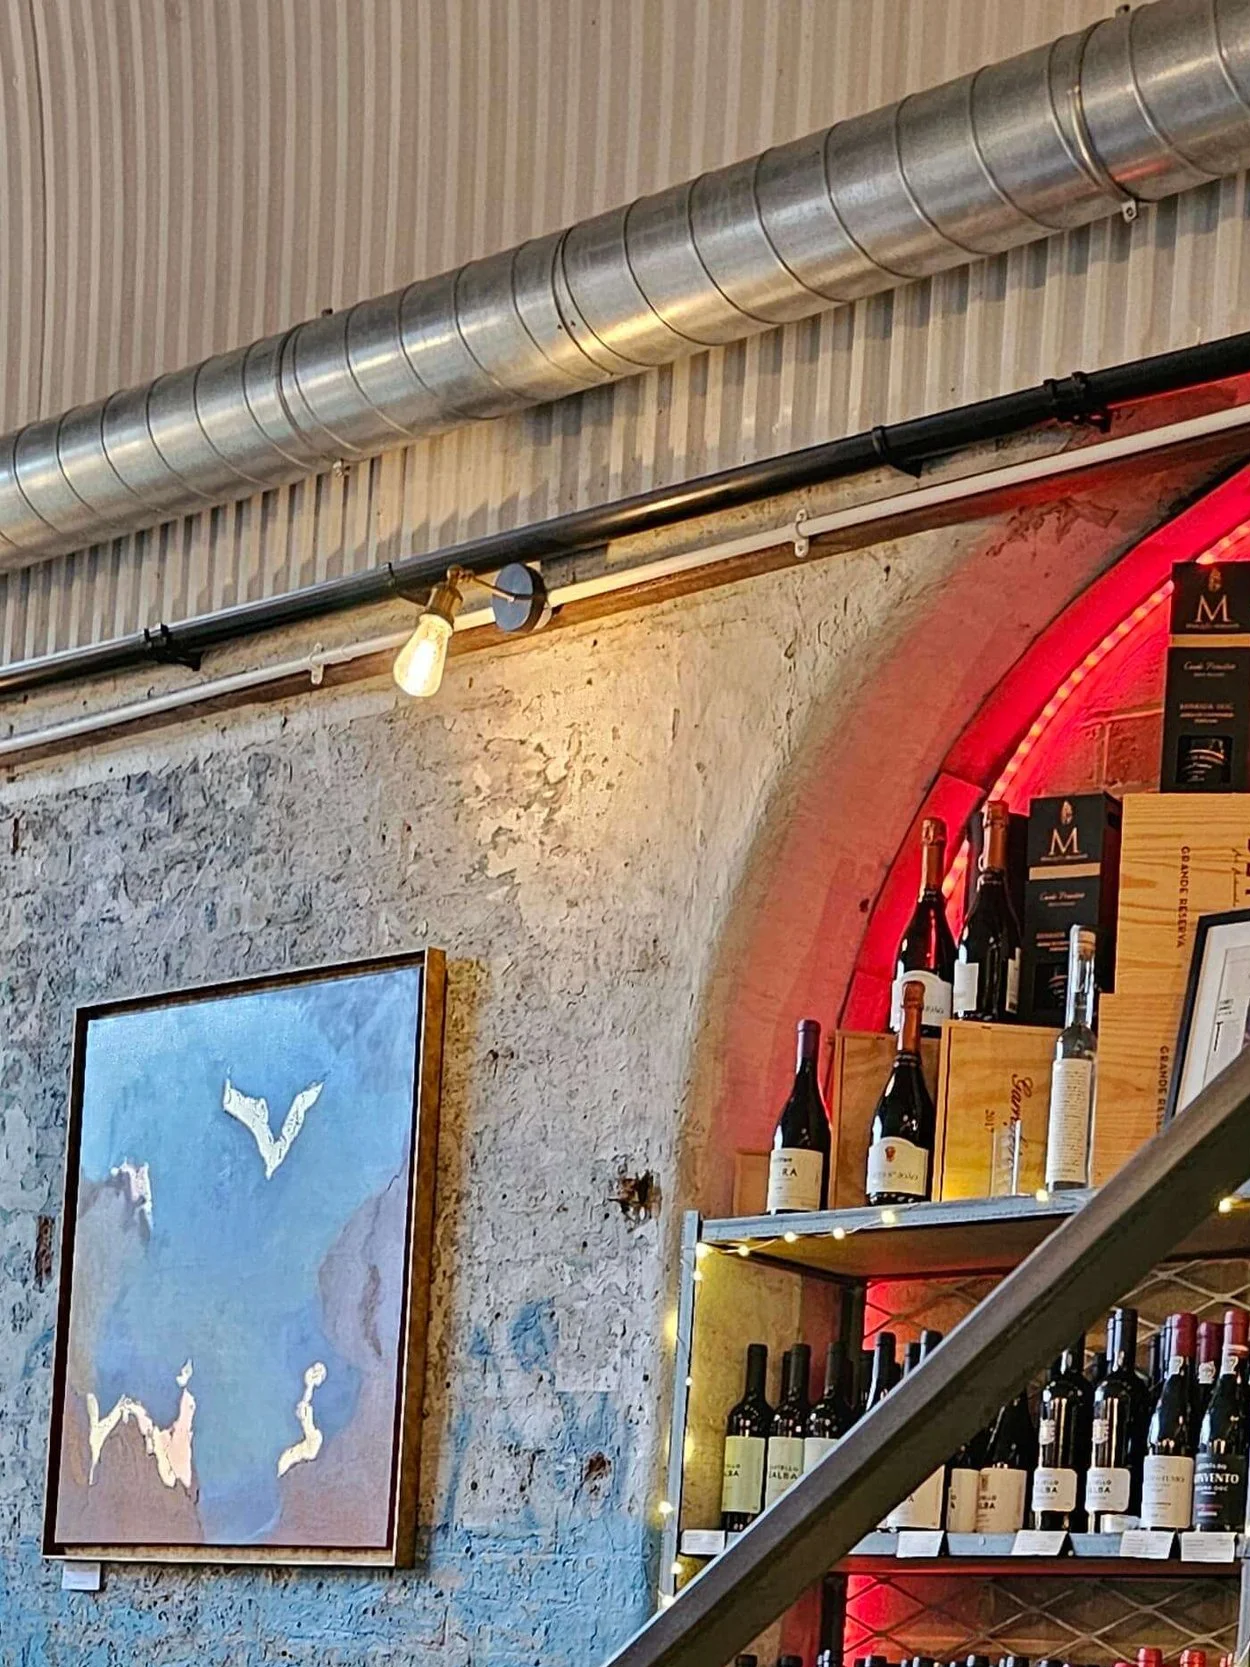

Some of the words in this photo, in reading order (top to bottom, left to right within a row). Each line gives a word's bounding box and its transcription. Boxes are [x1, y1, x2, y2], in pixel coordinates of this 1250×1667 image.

[1196, 595, 1231, 623] M
[1048, 827, 1080, 855] M
[1179, 846, 1191, 893] GRANDE
[1176, 895, 1188, 948] RESERVA
